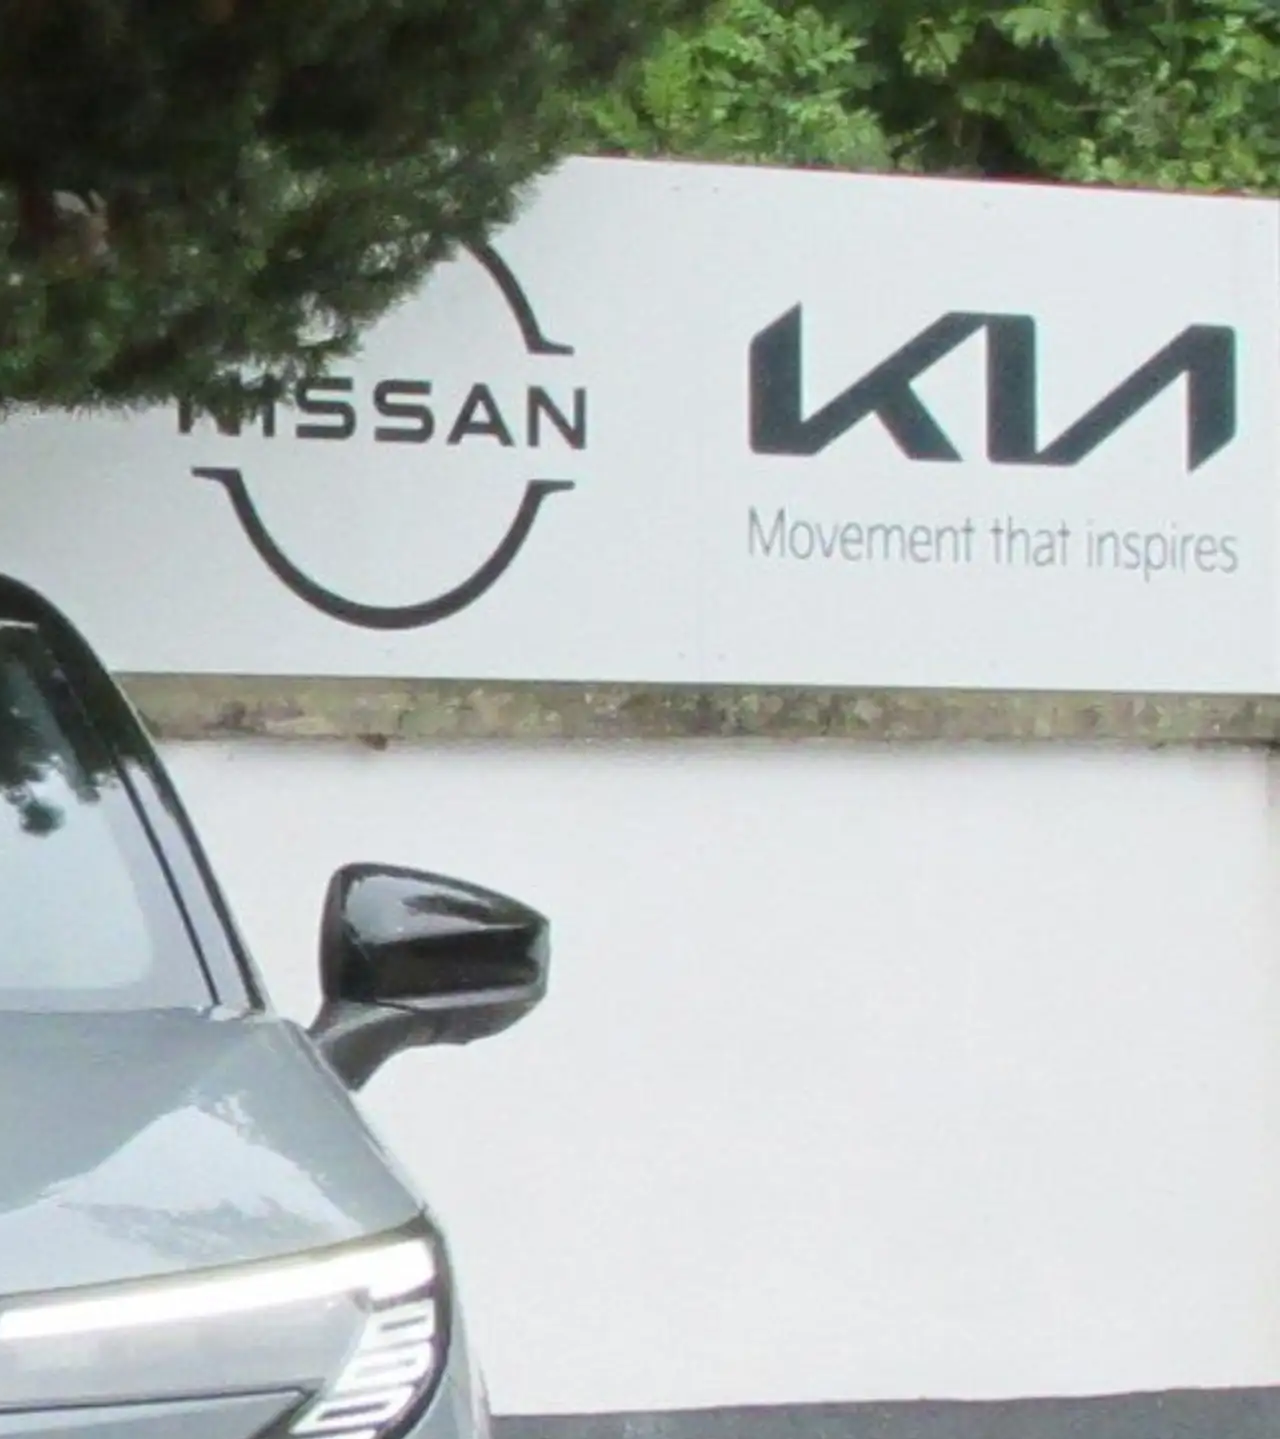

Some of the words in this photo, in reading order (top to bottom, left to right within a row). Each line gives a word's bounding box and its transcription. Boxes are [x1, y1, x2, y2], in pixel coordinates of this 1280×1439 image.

[749, 301, 1237, 473] KIA
[748, 506, 975, 563] Movement
[991, 516, 1070, 567] that
[1088, 519, 1239, 583] inspires
